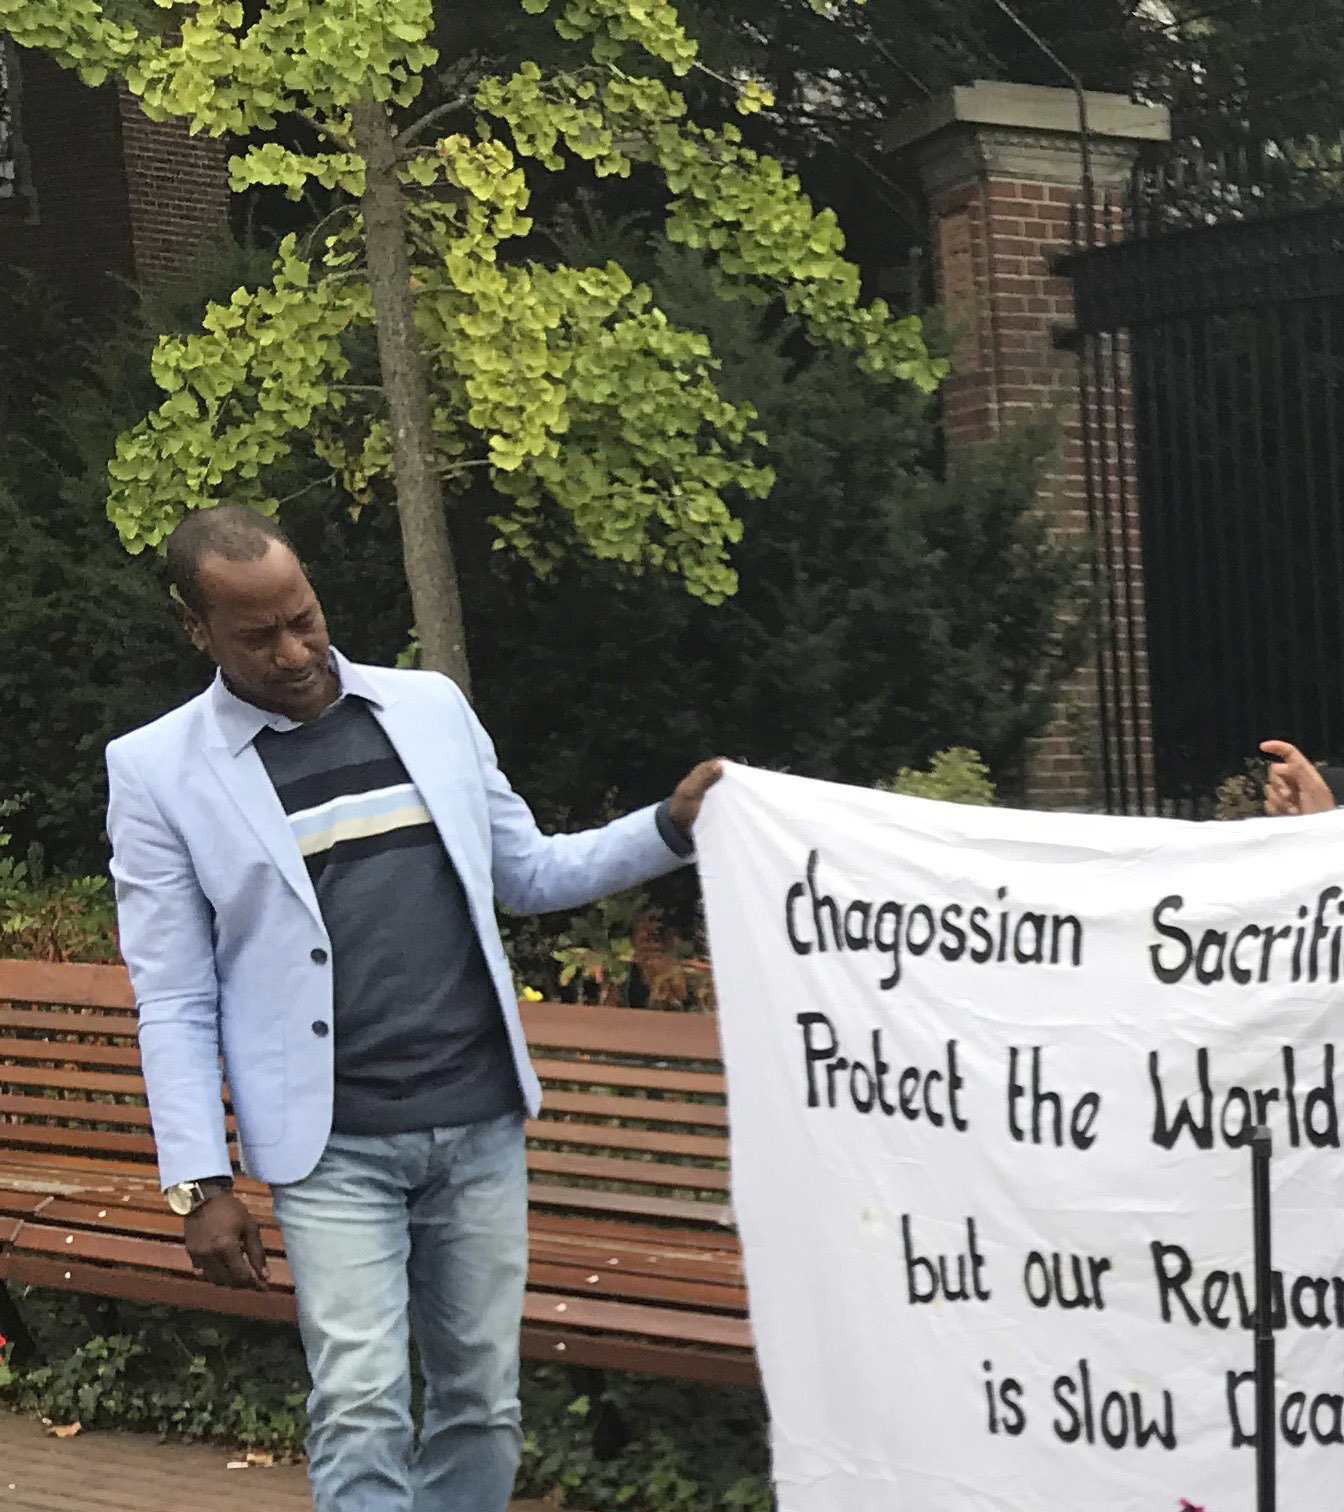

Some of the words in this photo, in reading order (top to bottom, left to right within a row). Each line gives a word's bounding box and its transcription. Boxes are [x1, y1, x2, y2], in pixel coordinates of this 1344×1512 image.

[796, 1012, 968, 1132] Protect
[1008, 1046, 1101, 1151] the
[1149, 1044, 1341, 1150] World
[901, 1213, 990, 1304] but
[1024, 1250, 1111, 1311] our
[983, 1359, 1026, 1436] is
